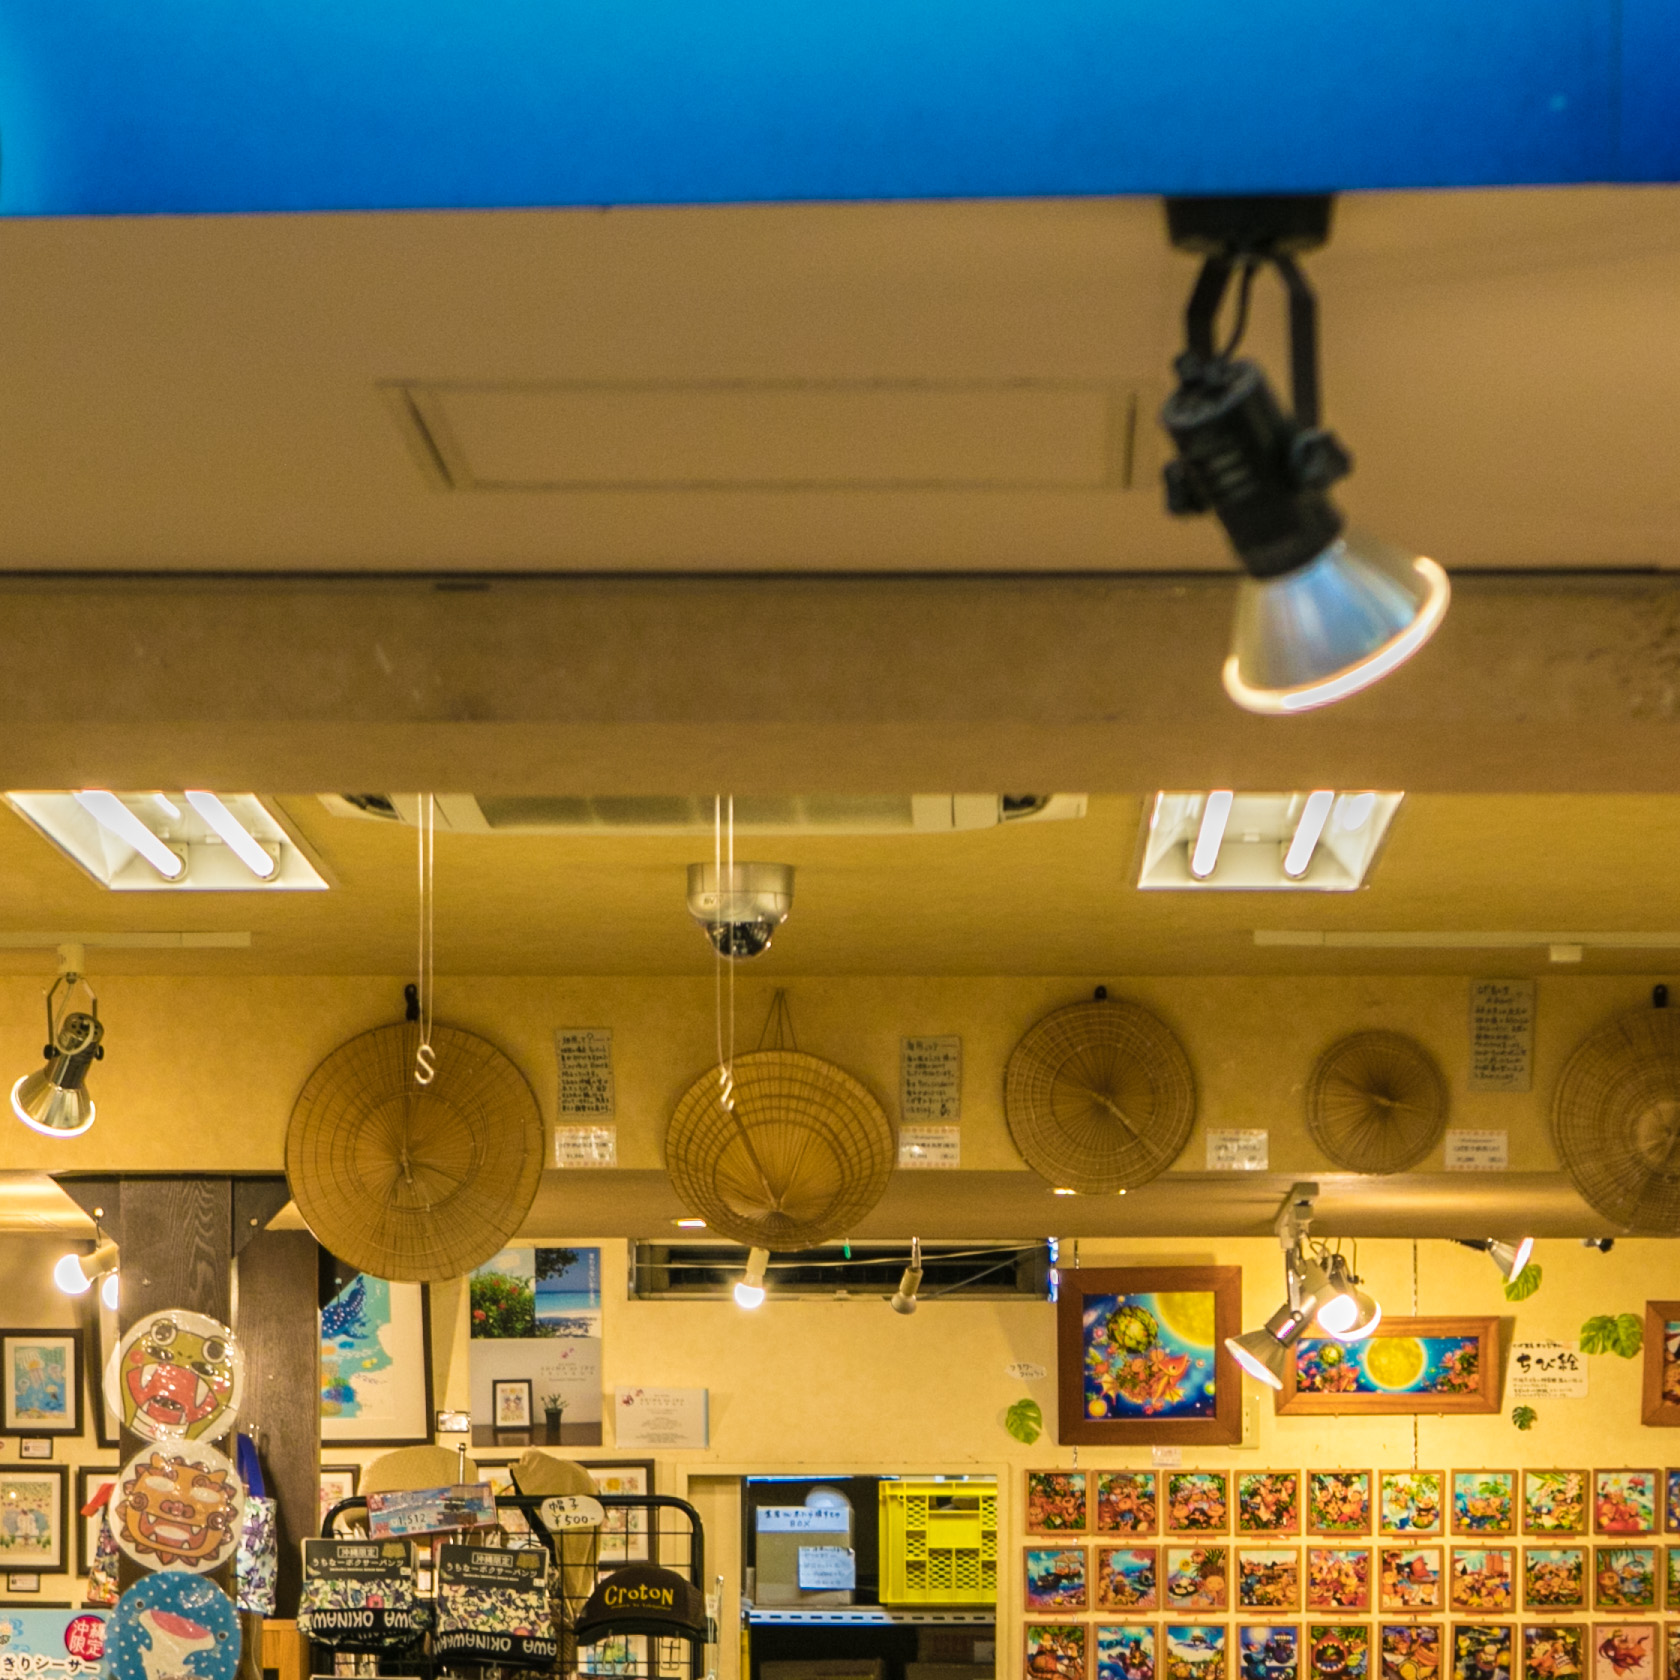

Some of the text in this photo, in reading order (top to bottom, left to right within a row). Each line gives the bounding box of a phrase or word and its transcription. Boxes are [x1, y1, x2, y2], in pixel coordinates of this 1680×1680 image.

[1517, 1353, 1579, 1373] ちび絵
[549, 1498, 579, 1511] 帽子
[313, 1558, 404, 1568] うちなーボクサーパンツ
[446, 1562, 538, 1578] うちなーボクサーパンツ
[74, 1620, 108, 1640] 沖縄
[70, 1637, 105, 1656] 限定
